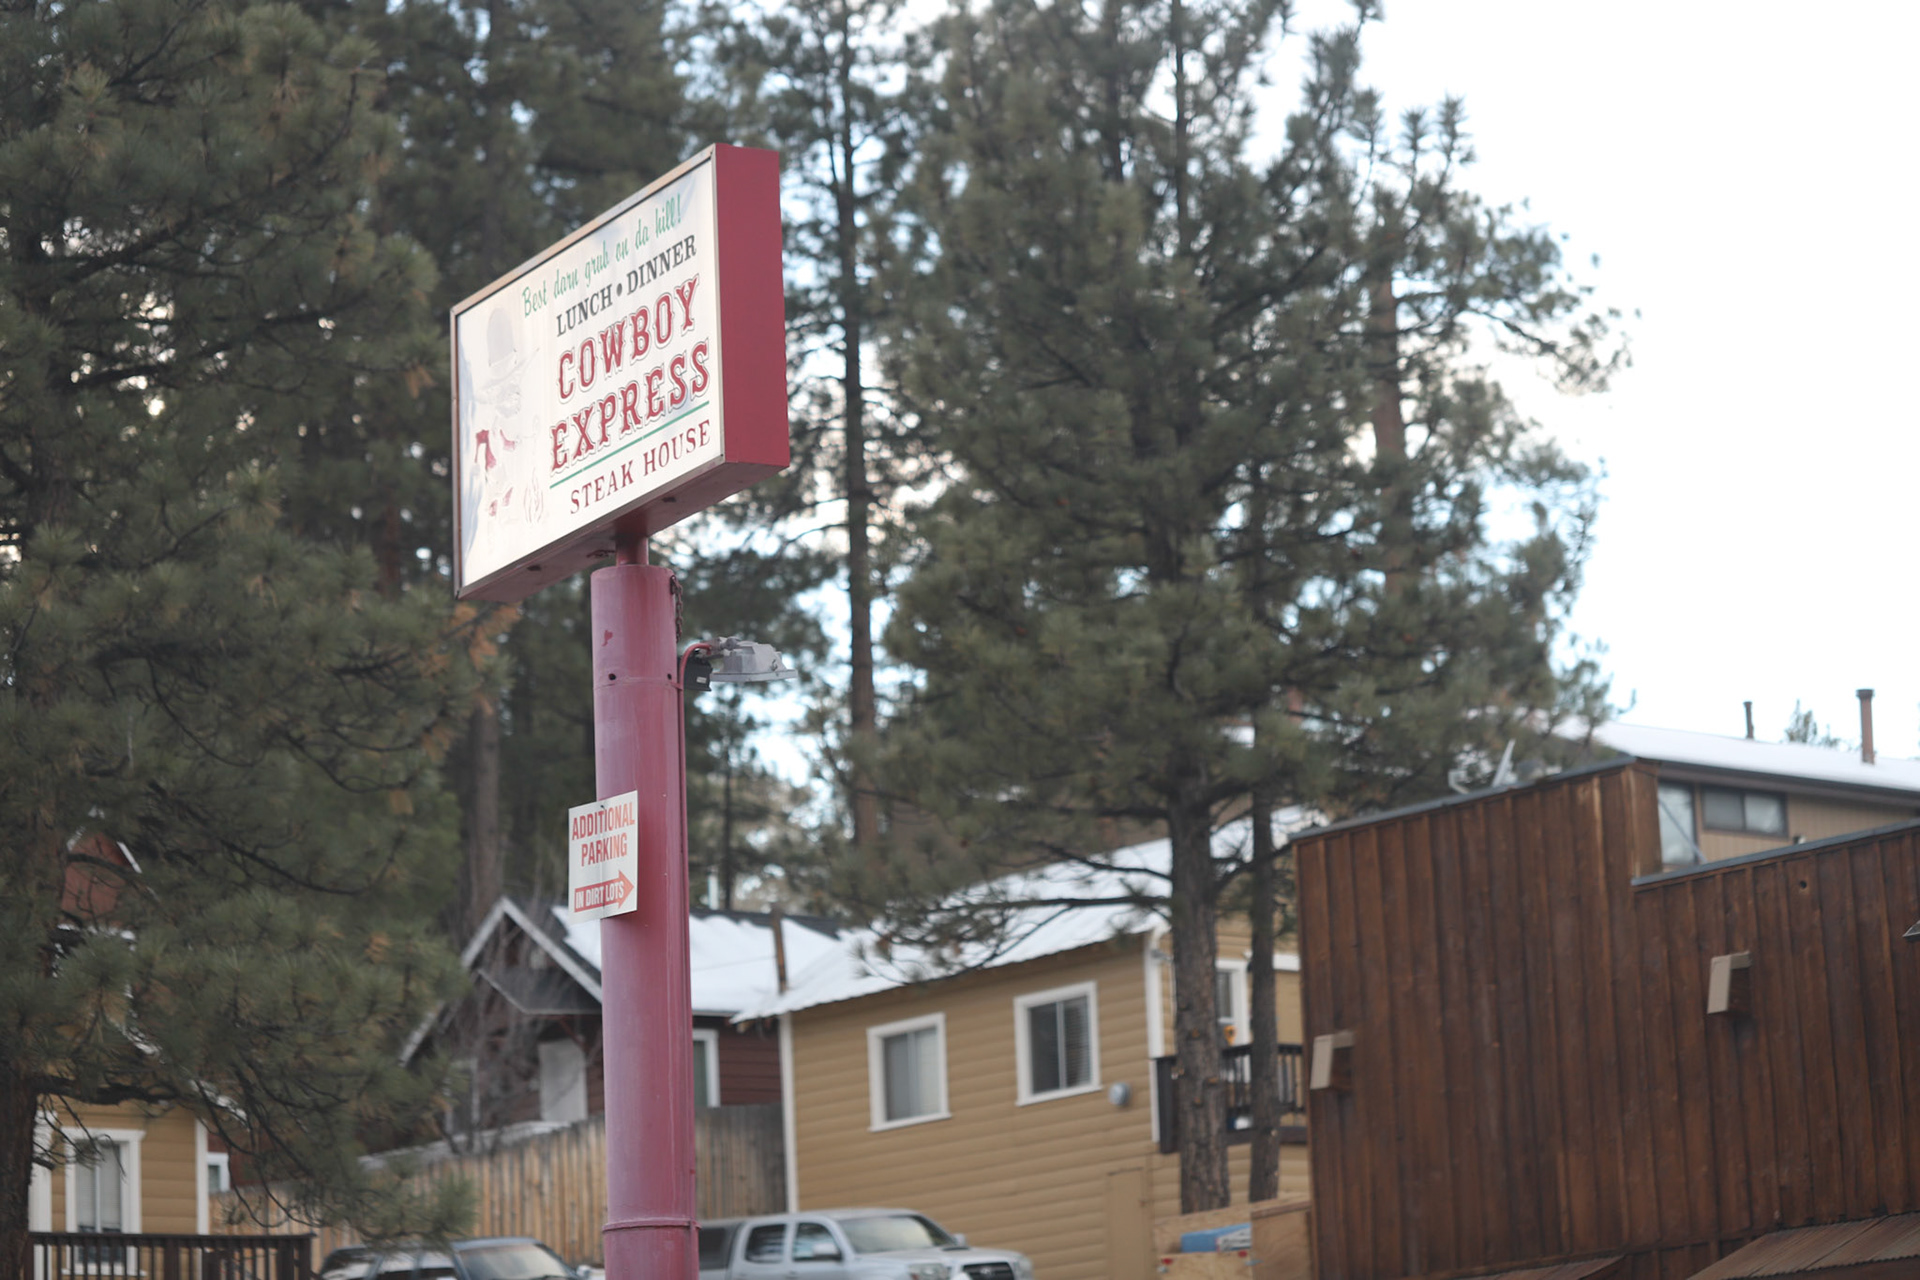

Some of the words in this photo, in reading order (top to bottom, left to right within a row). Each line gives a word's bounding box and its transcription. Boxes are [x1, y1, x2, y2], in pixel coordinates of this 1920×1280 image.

[522, 281, 547, 318] Best
[554, 265, 578, 297] darn
[585, 240, 609, 287] grub
[616, 237, 629, 262] on
[635, 219, 649, 249] da
[656, 193, 682, 238] hill!
[557, 284, 612, 337] LUNCH
[627, 235, 697, 295] DINNER
[557, 275, 699, 402] COWBOY
[550, 339, 710, 475] EXPRESS
[570, 460, 634, 514] STEAK
[643, 420, 710, 477] HOUSE
[572, 802, 635, 840] ADDITIONAL
[581, 833, 627, 867] PARKING
[575, 890, 584, 909] IN
[586, 886, 604, 907] DIRT
[605, 881, 624, 902] LOTS
